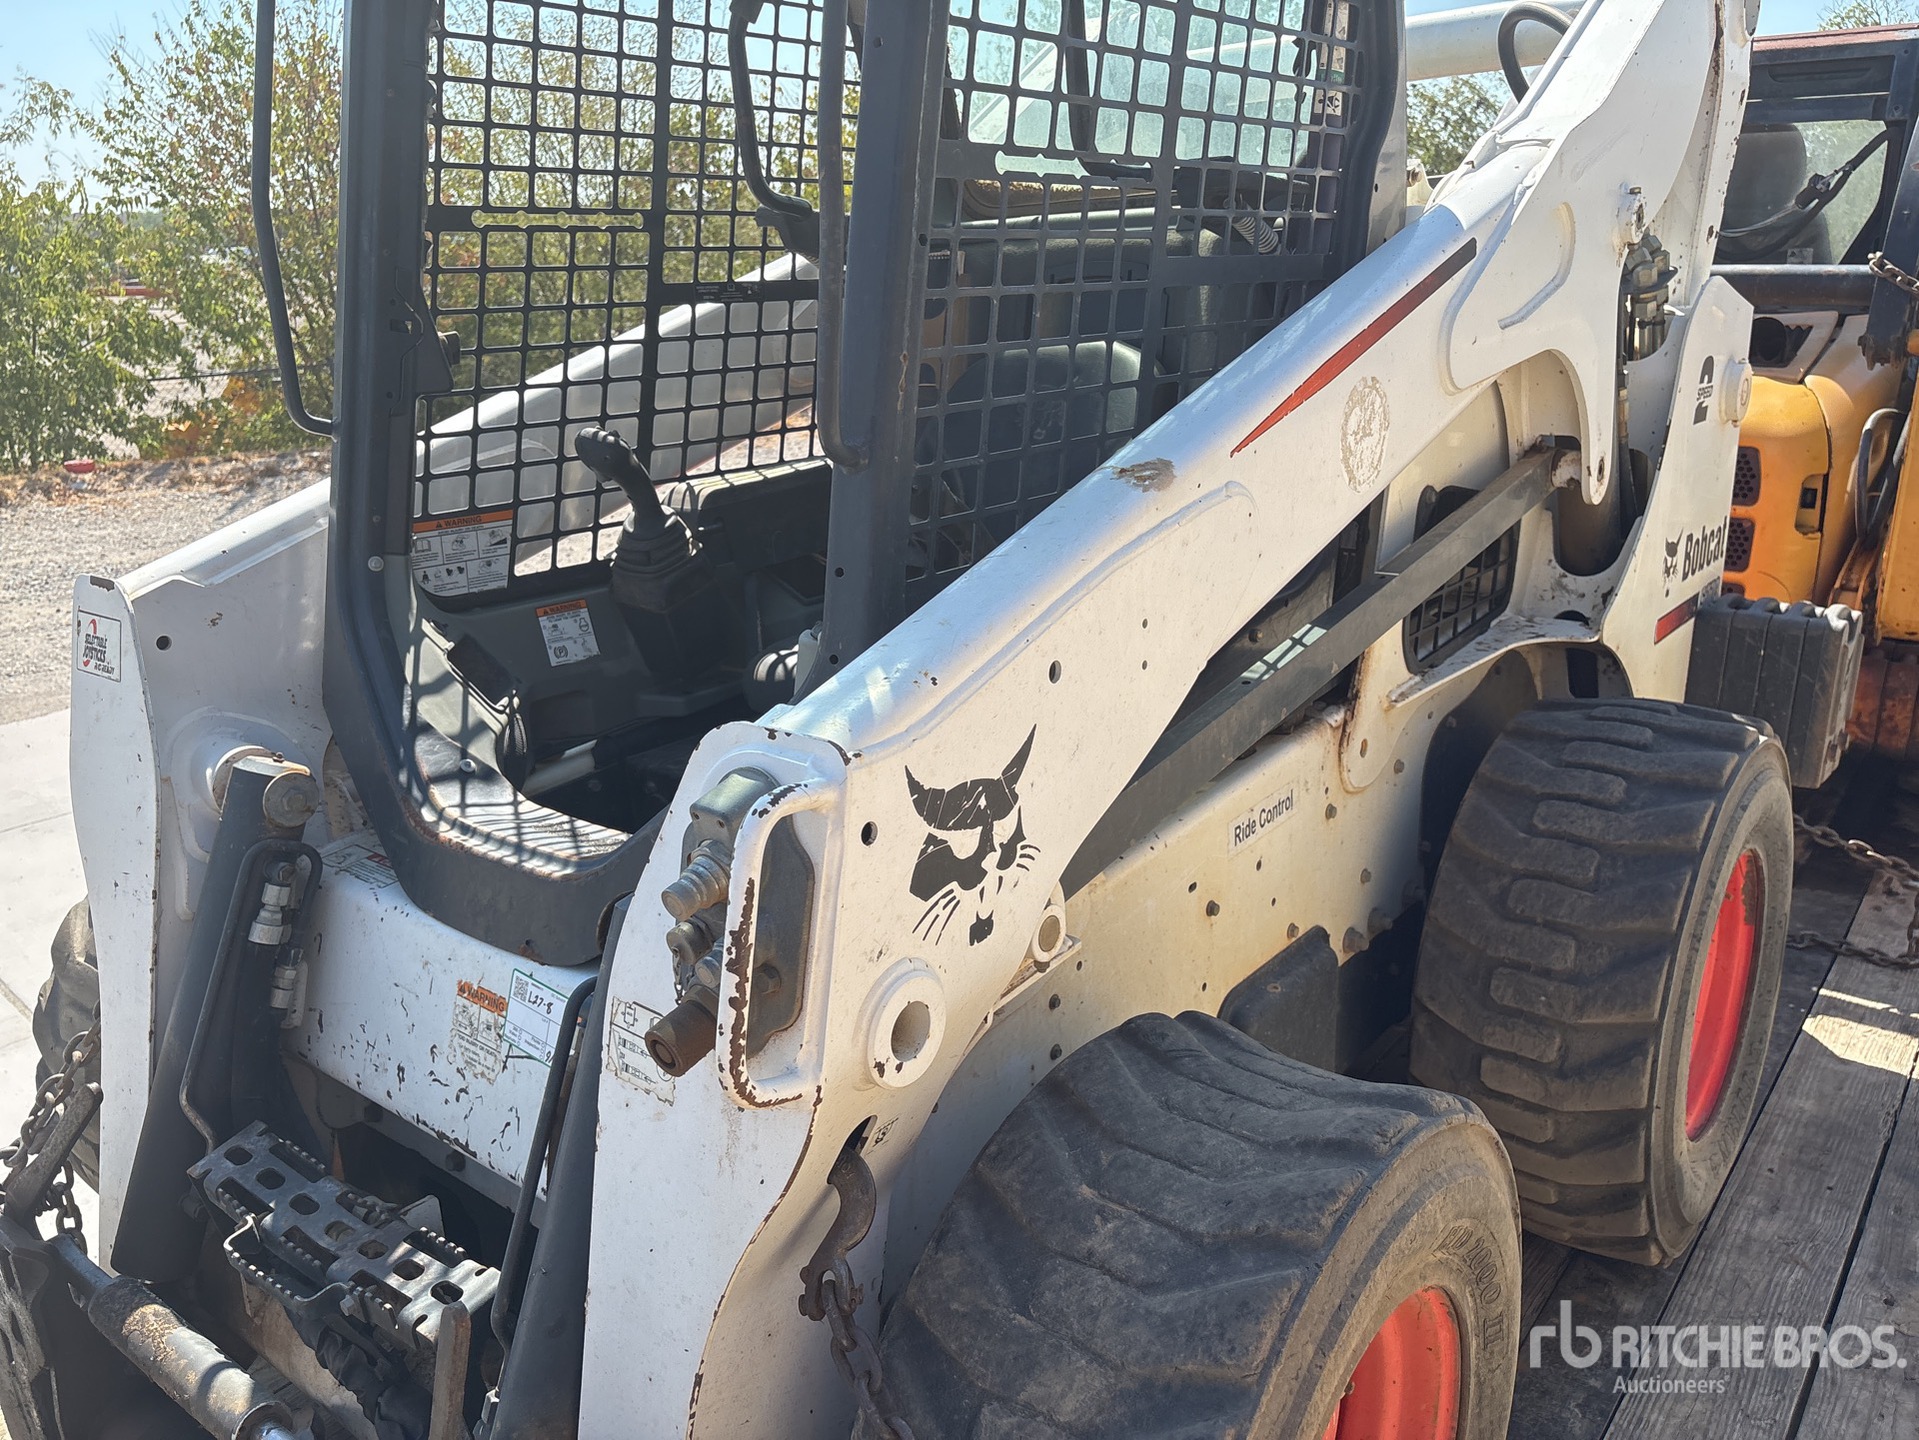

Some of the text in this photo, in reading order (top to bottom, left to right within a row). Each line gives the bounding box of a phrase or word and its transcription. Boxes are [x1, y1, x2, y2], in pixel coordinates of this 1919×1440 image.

[1696, 385, 1714, 402] SPEED
[444, 515, 482, 528] WARNING
[1682, 515, 1727, 582] Bobcat
[1234, 788, 1294, 847] Ride Control
[468, 986, 505, 1012] WARNING
